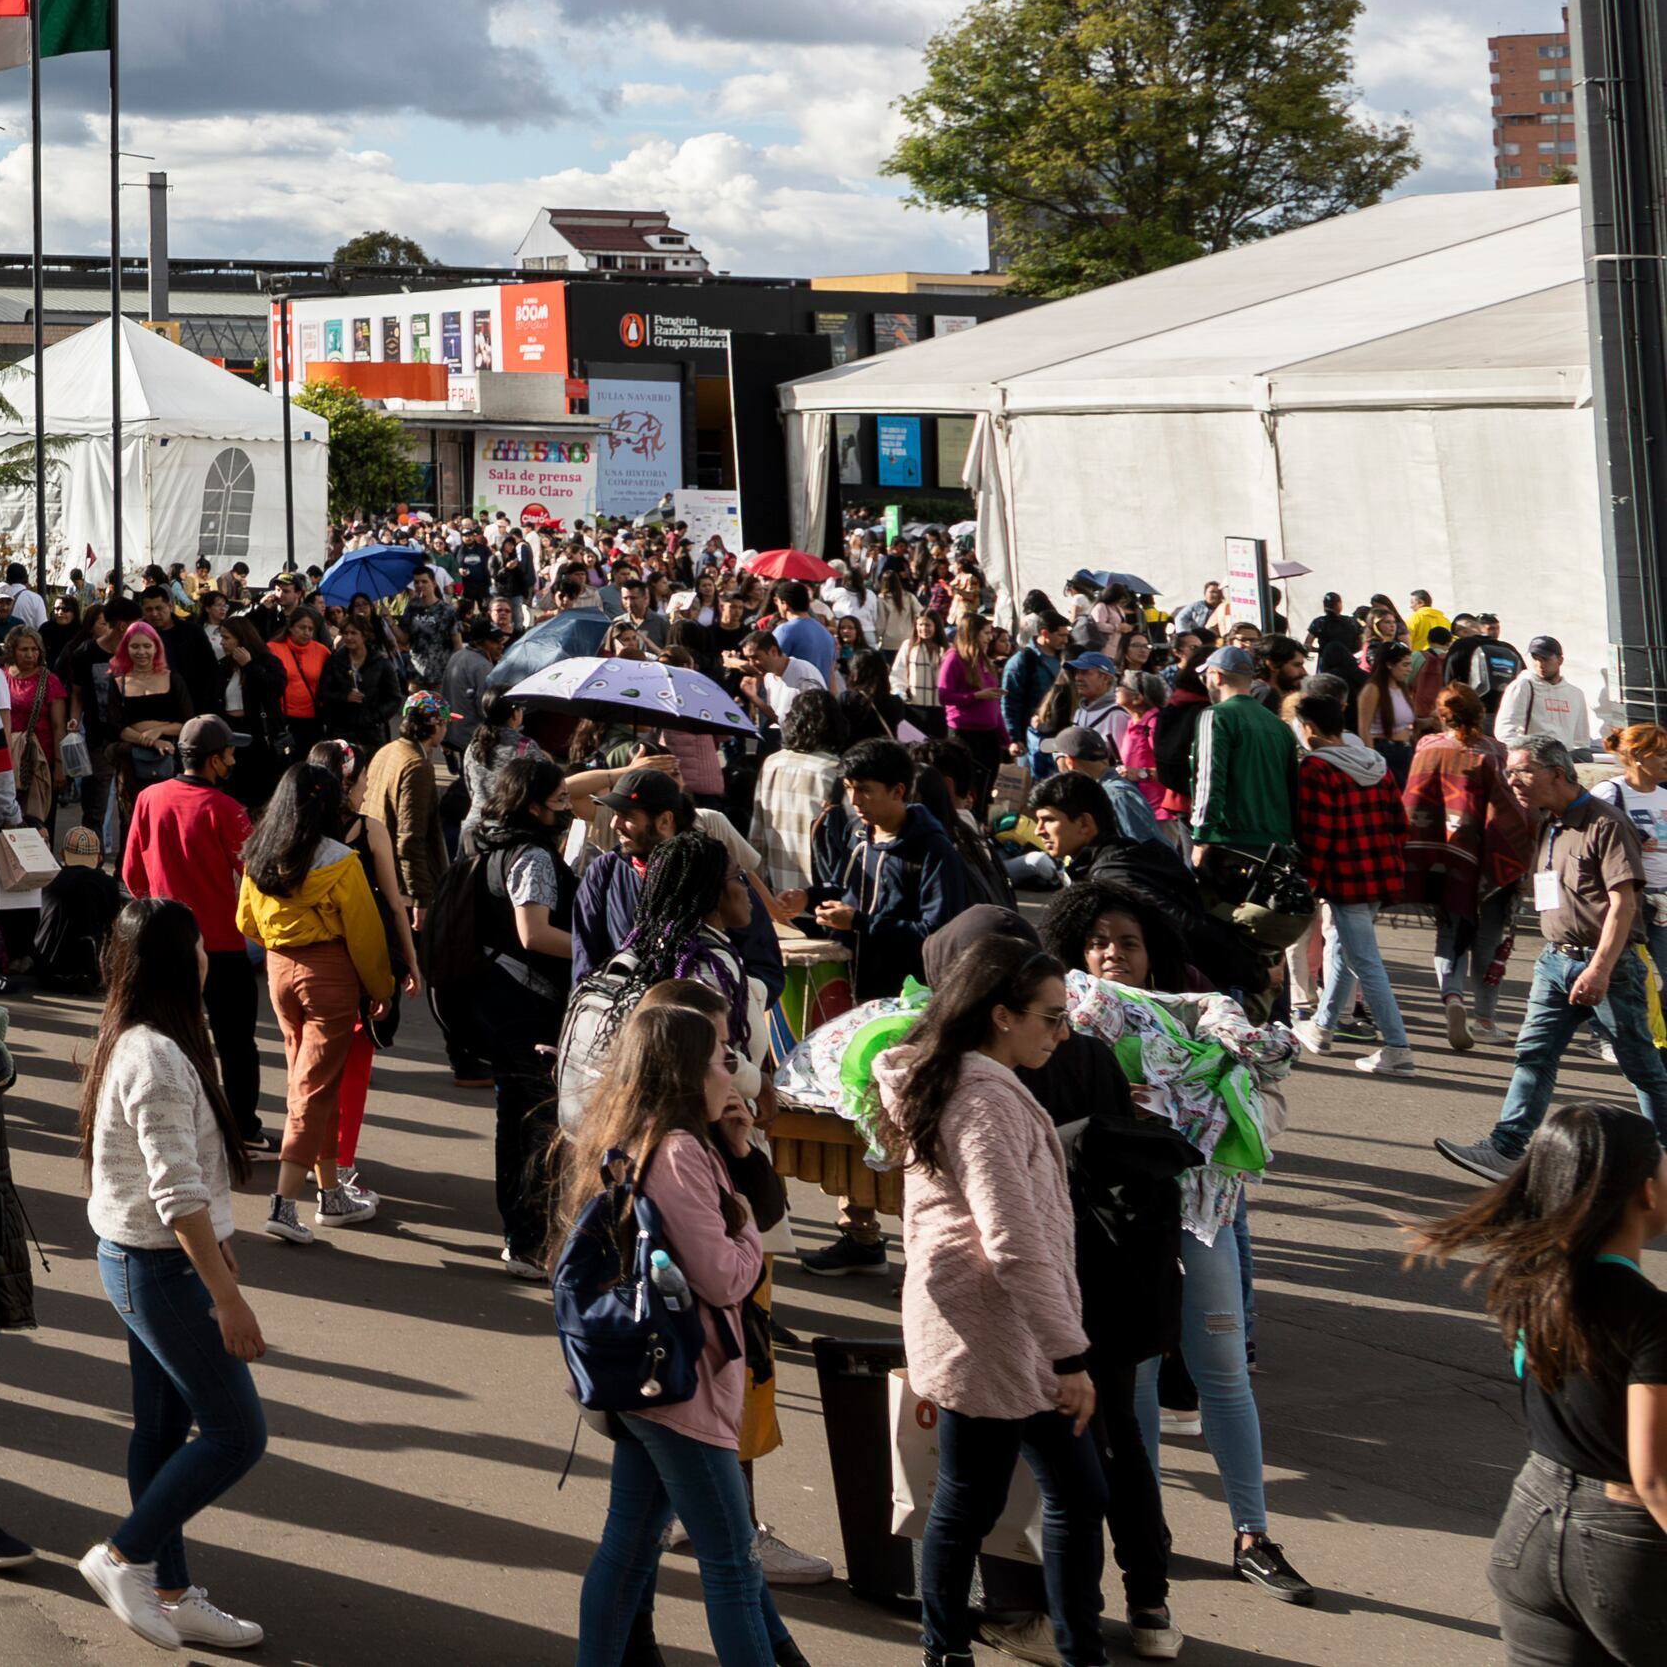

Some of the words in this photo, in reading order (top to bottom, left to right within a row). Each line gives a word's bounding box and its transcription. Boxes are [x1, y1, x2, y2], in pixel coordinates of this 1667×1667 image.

[515, 304, 548, 322] BOOM
[654, 315, 698, 328] Penguin
[654, 326, 698, 336] Random
[654, 336, 688, 349] Grupo
[689, 338, 729, 349] Editoria
[597, 392, 624, 401] JULIA
[627, 393, 671, 402] NAVARRO
[489, 469, 516, 480] Sala
[520, 470, 535, 481] de
[539, 473, 582, 483] prensa
[608, 478, 665, 487] COMPARTIDA
[498, 484, 536, 496] FILBo
[539, 486, 573, 497] Claro
